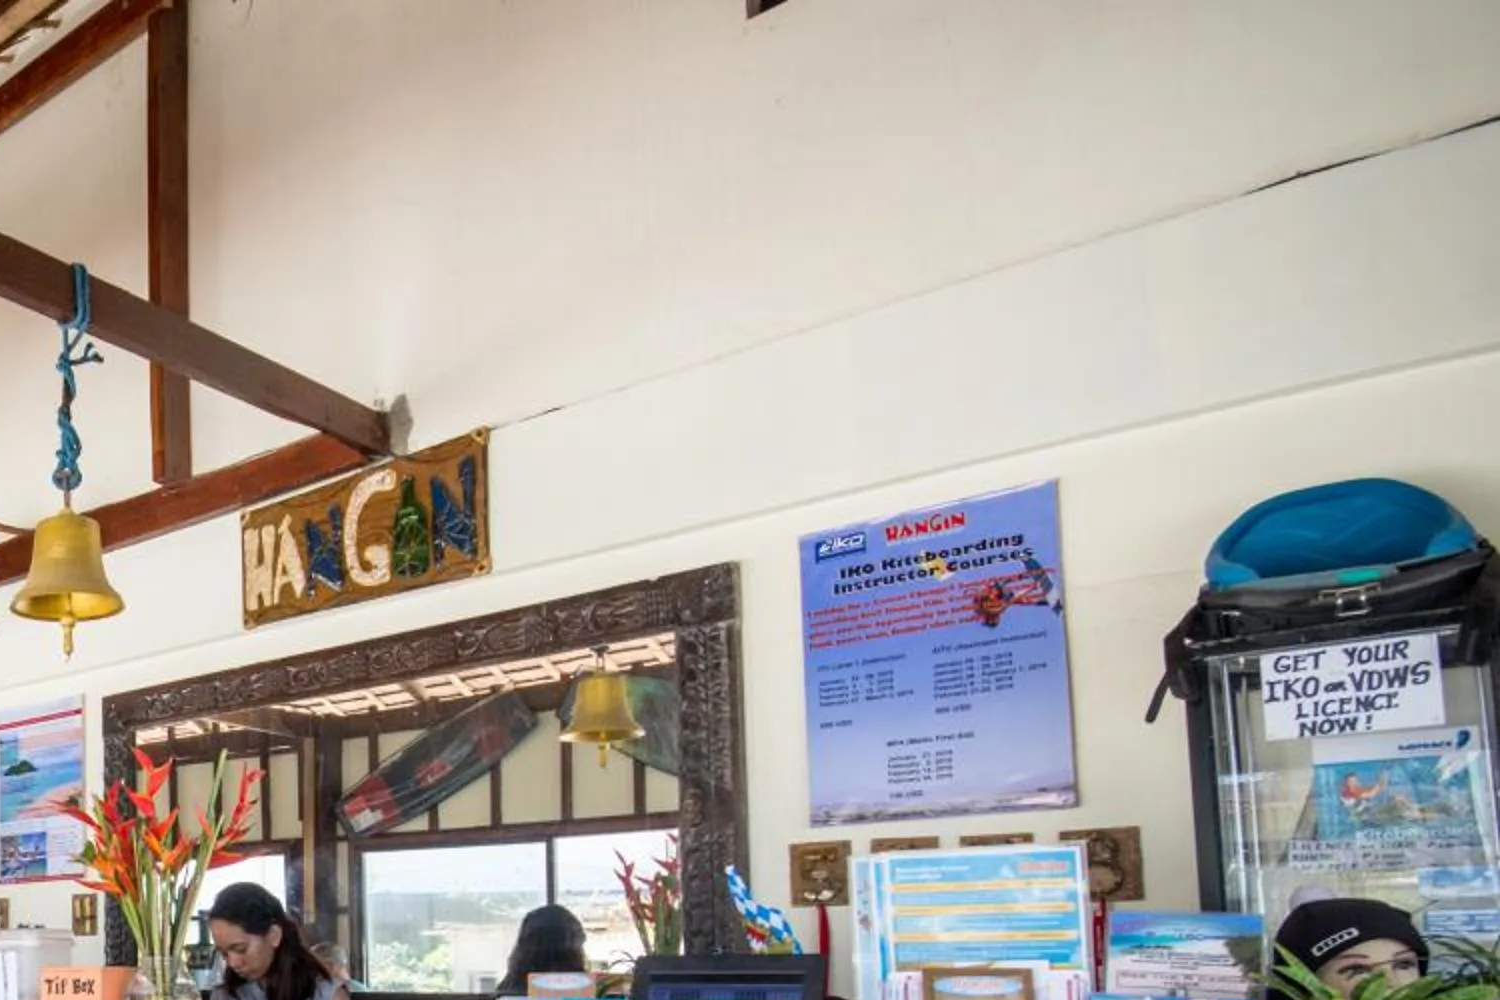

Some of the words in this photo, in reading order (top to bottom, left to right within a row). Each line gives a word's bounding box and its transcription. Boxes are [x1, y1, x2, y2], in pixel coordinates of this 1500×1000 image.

[882, 534, 1024, 570] Kiteboarding
[834, 566, 940, 595] Instructor
[946, 548, 1034, 572] Courses
[1273, 650, 1326, 674] GET
[1344, 640, 1409, 667] YOUR
[1264, 676, 1320, 704] IKO
[1348, 661, 1432, 693] VDWS
[1296, 691, 1399, 720] LICENCE
